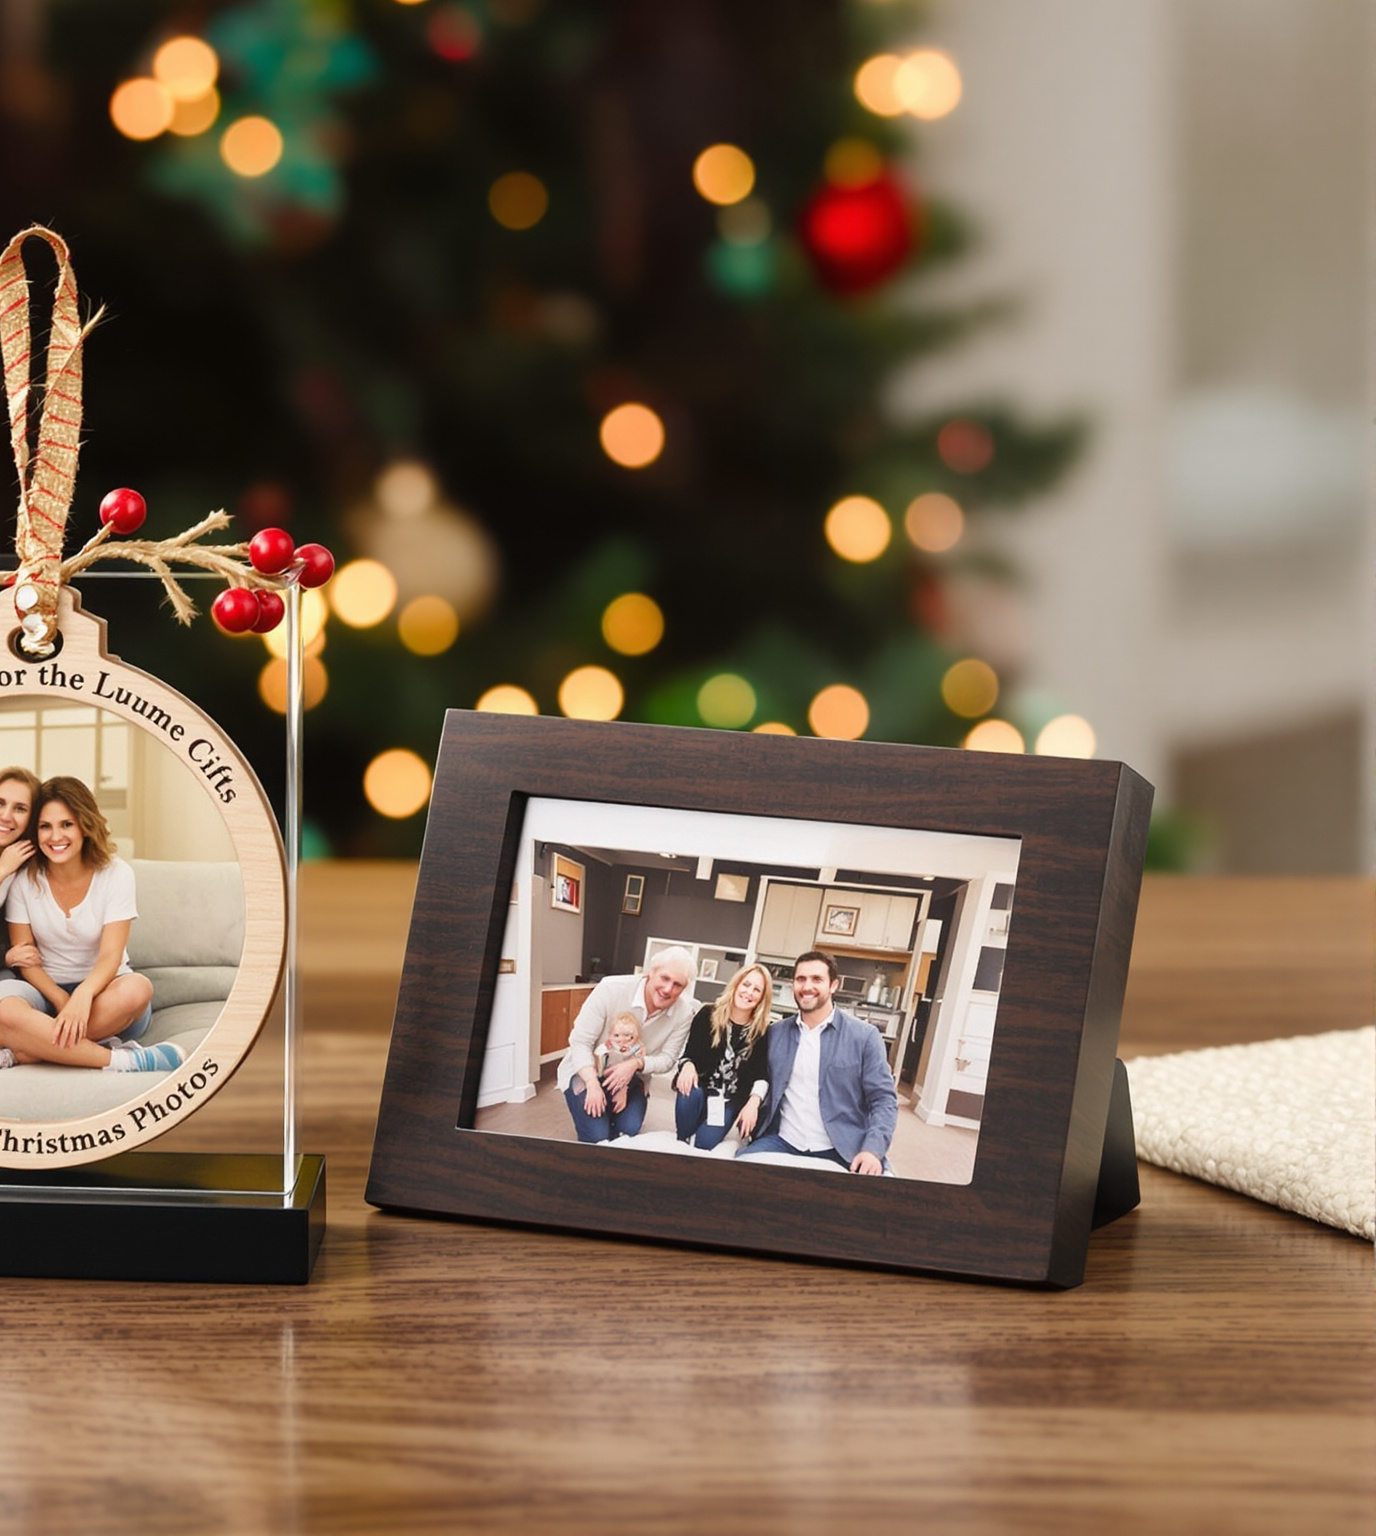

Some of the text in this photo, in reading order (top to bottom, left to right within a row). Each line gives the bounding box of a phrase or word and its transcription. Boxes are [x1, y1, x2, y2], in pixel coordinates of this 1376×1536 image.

[38, 662, 86, 692] the
[92, 670, 186, 742] Luume
[126, 1057, 220, 1133] Photos
